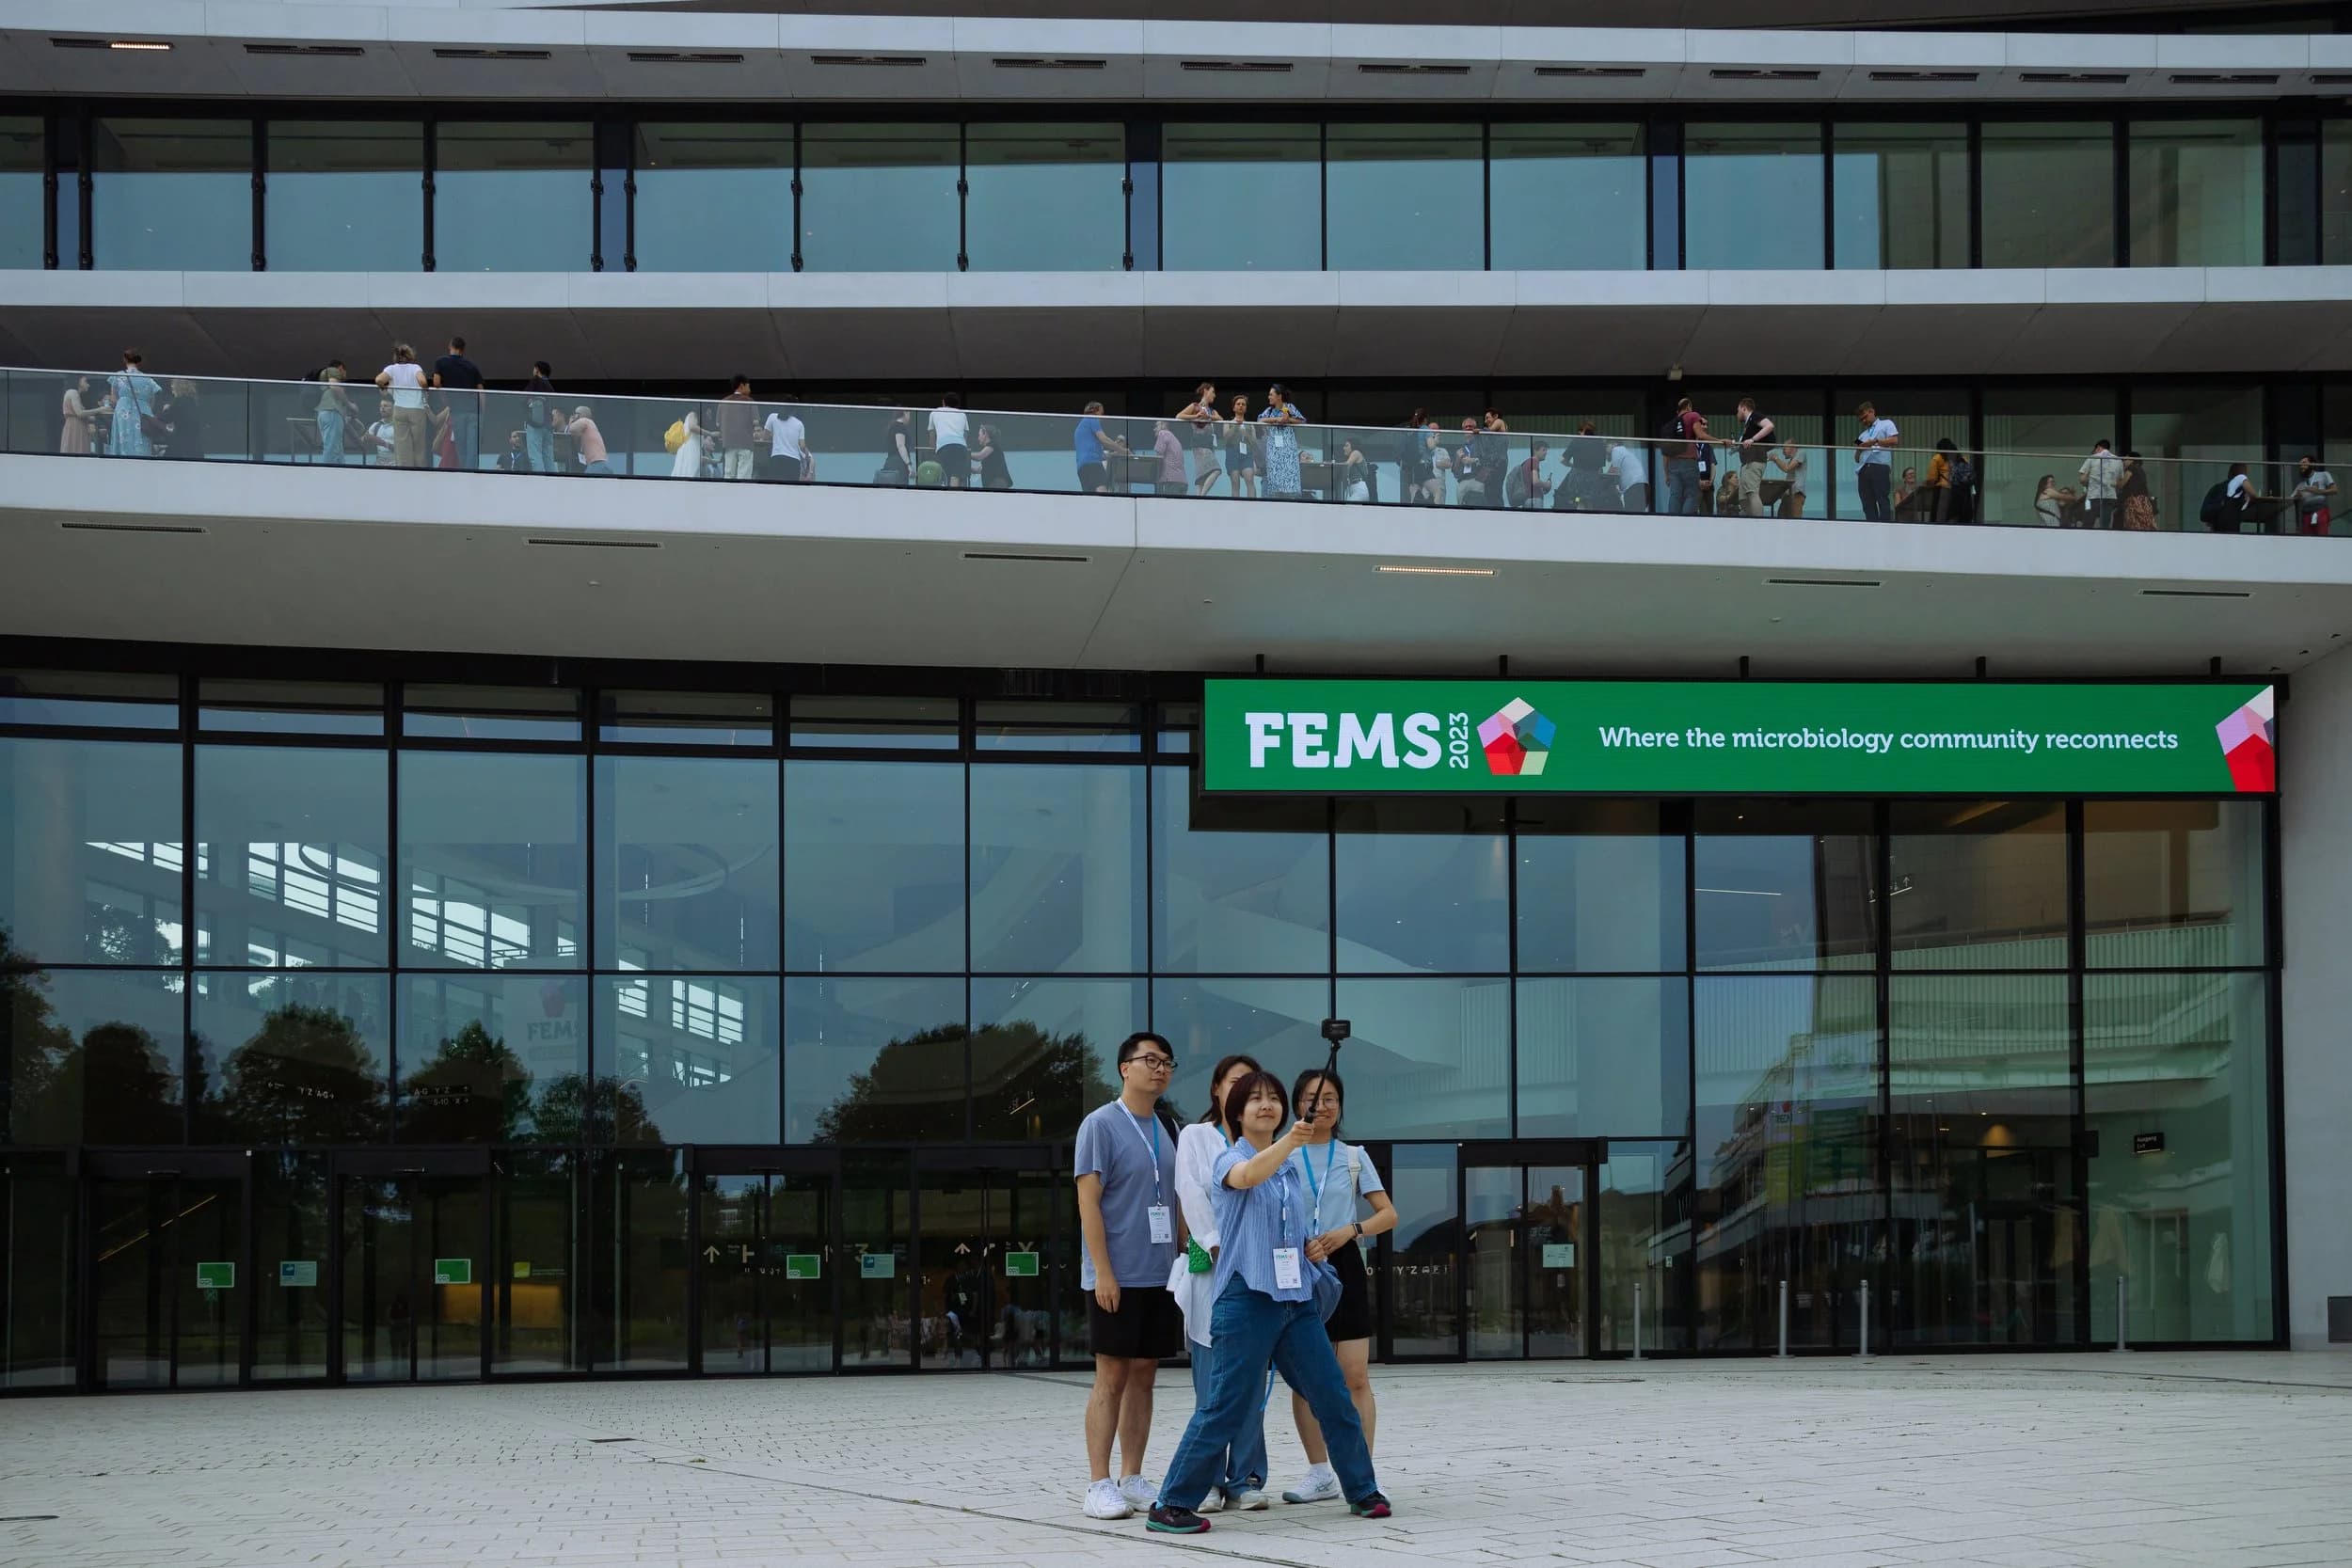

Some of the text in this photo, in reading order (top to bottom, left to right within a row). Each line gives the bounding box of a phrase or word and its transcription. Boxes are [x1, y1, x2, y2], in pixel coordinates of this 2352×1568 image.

[1245, 712, 1442, 769] FEMS
[1448, 712, 1470, 769] 2023
[1598, 726, 2179, 754] Where the microbiology community reconnects
